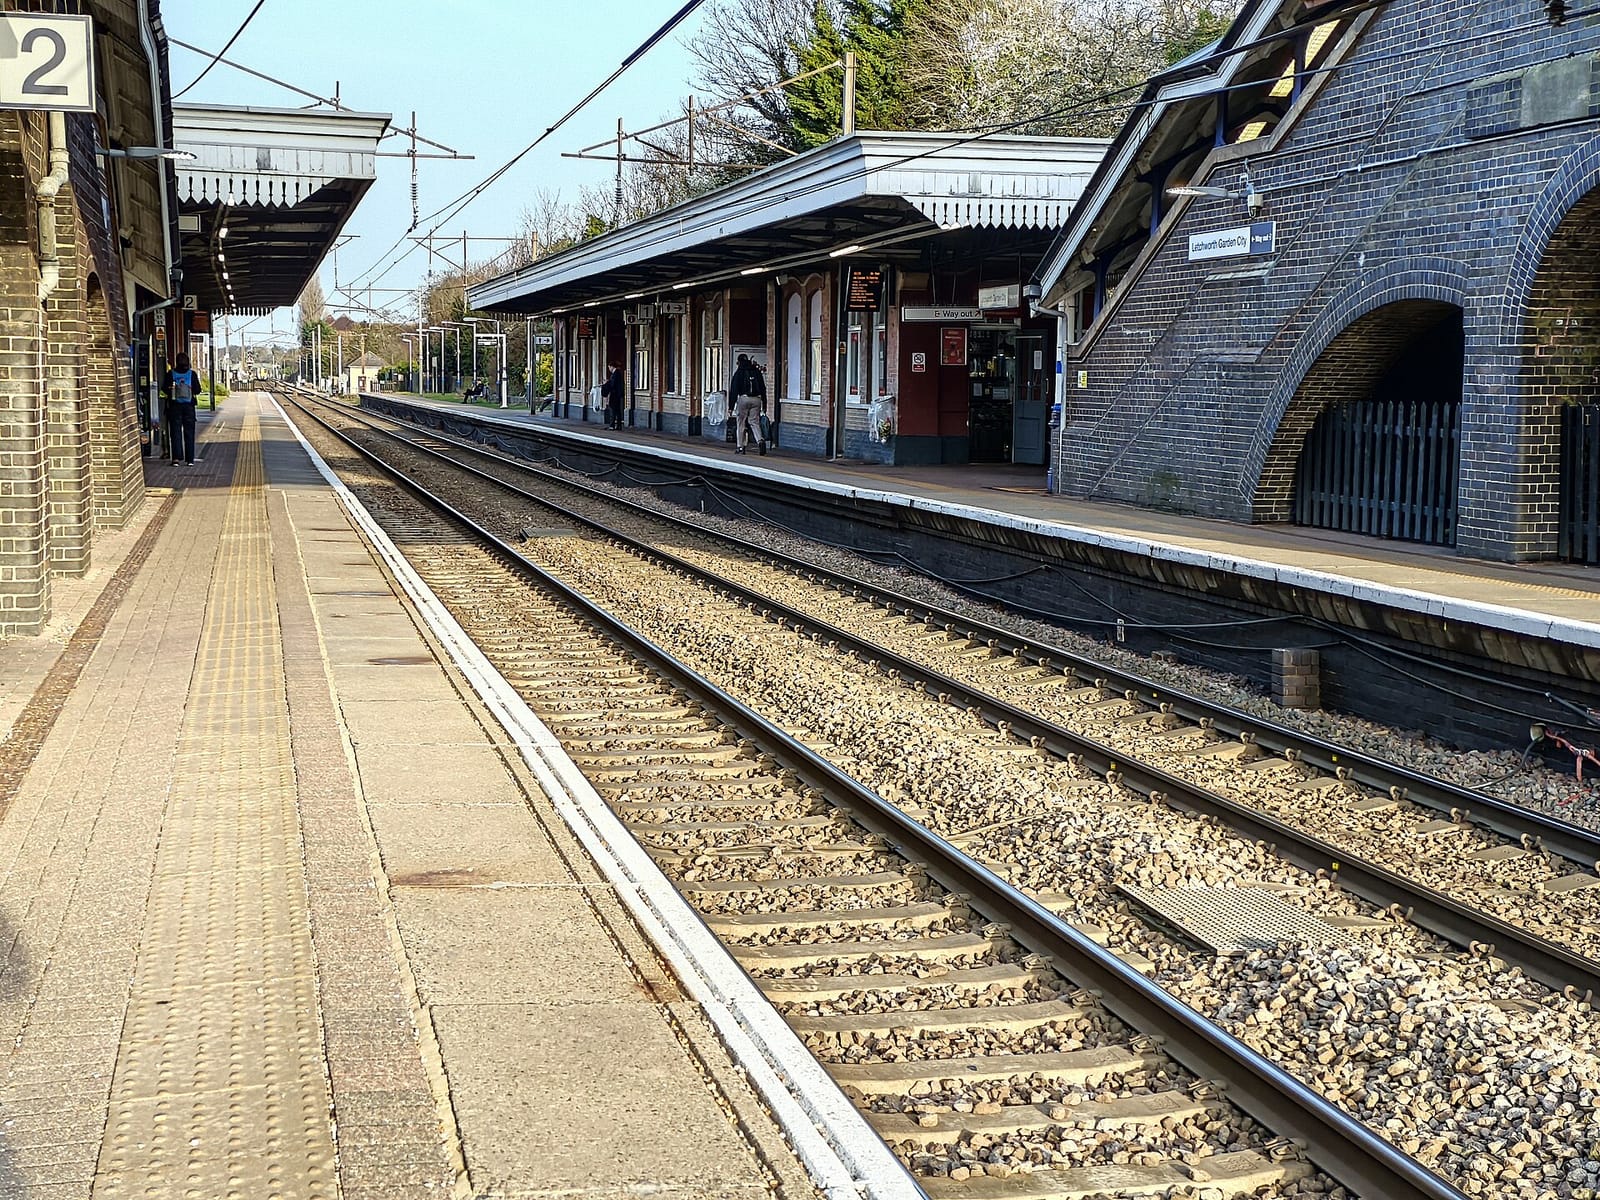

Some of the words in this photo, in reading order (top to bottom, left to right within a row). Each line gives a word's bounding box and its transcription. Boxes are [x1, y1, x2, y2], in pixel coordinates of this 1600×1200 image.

[21, 27, 68, 96] 2
[1191, 240, 1218, 252] Letchworth
[1218, 237, 1237, 249] Garden
[1237, 235, 1248, 248] City
[185, 296, 194, 309] 2
[643, 306, 649, 317] 1
[942, 310, 959, 319] Way
